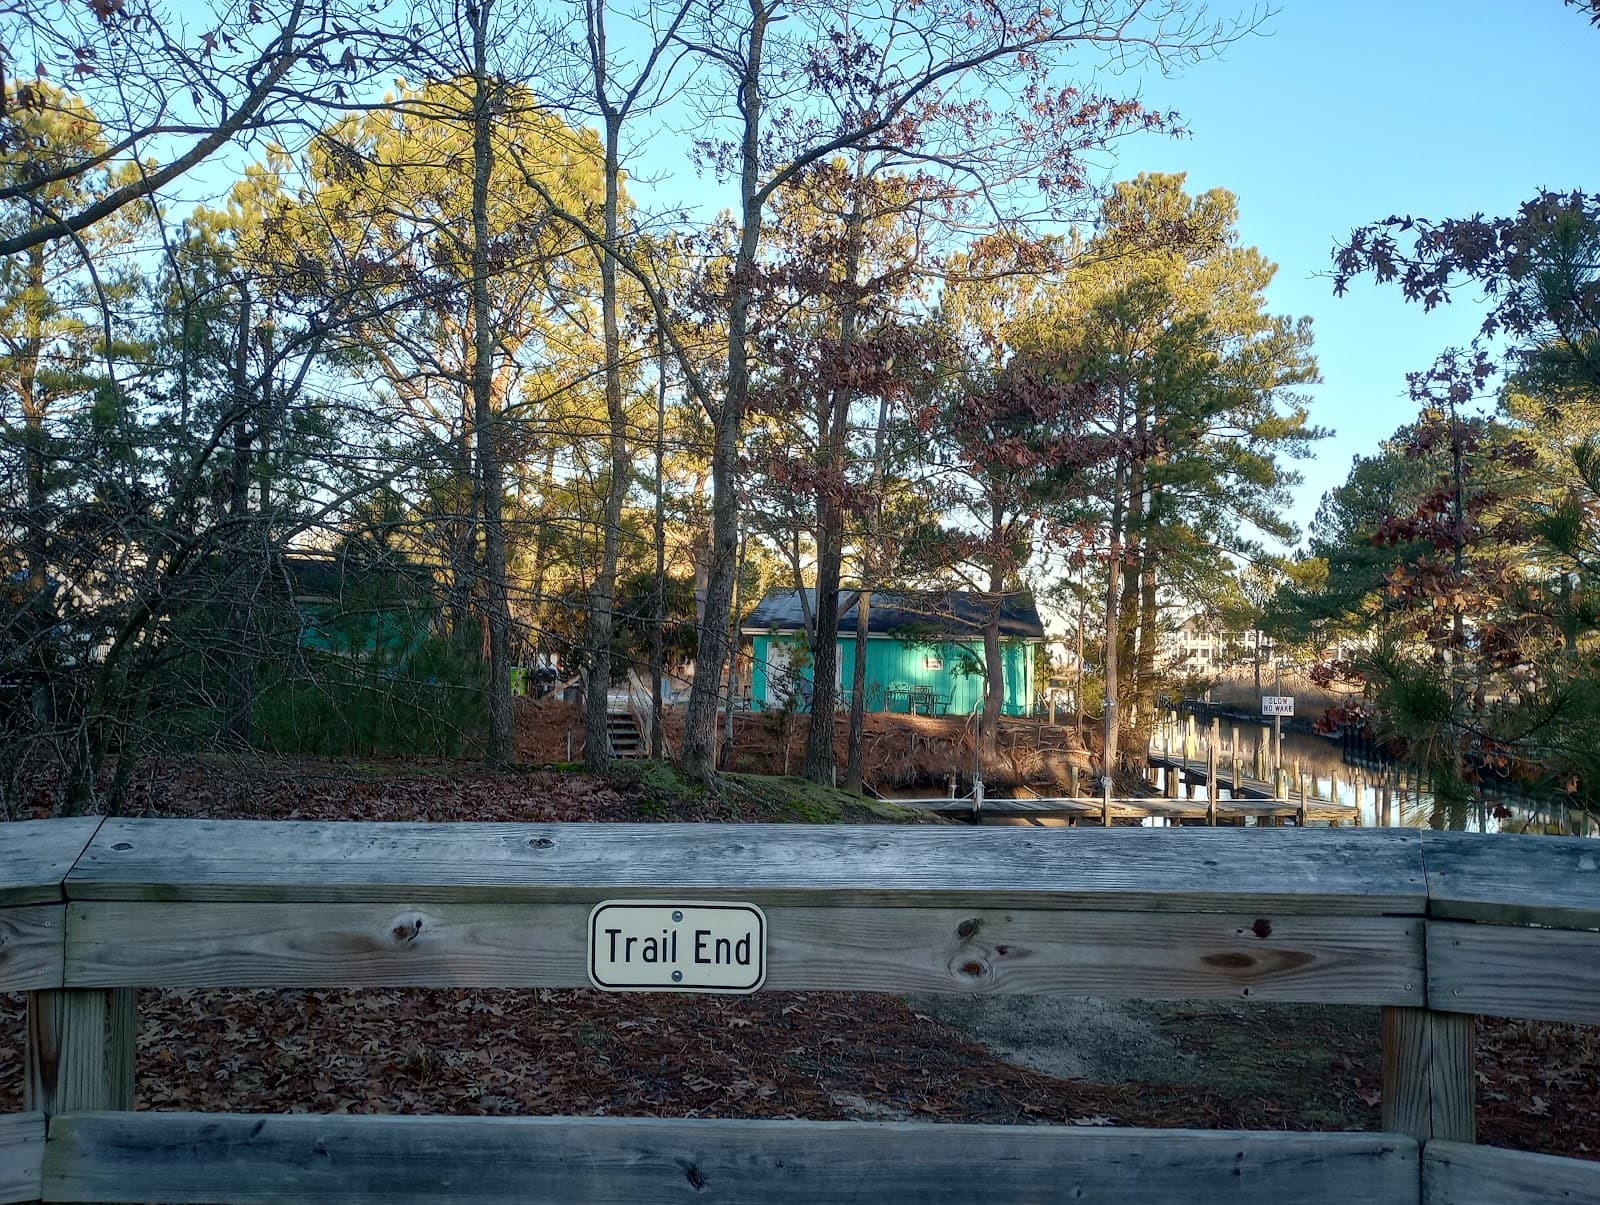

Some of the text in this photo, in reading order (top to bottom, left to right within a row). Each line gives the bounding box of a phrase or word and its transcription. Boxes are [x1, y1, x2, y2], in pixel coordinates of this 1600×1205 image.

[1263, 704, 1293, 713] NO WAKE
[605, 929, 751, 965] Trail End
